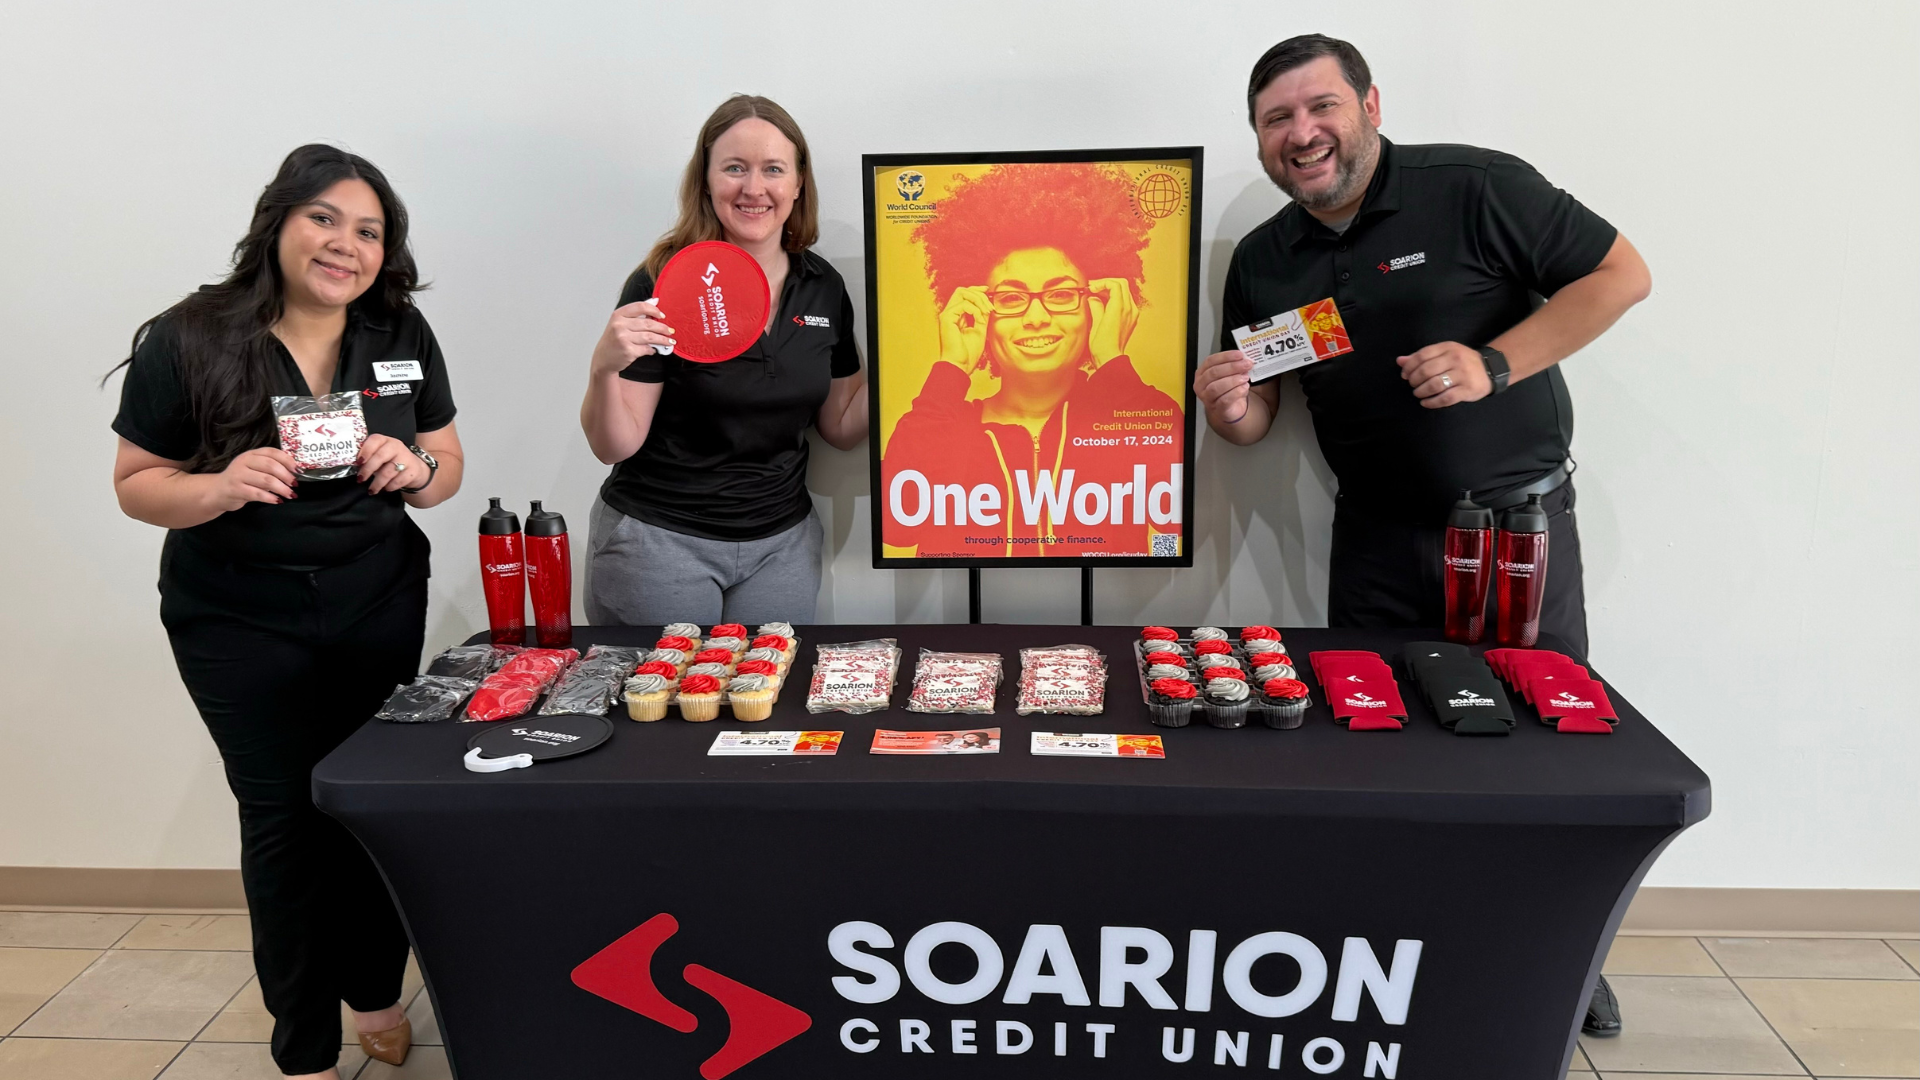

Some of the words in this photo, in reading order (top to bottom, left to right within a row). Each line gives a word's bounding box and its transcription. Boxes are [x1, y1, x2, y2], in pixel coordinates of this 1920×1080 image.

[1389, 251, 1425, 266] SOARION
[697, 295, 711, 335] soarion.org
[711, 286, 731, 337] SOARION
[376, 383, 411, 392] SOARION
[1113, 408, 1173, 418] International
[1092, 422, 1121, 431] Credit
[1124, 421, 1152, 430] Union
[1154, 421, 1173, 431] Day
[303, 440, 353, 453] SOARION
[1072, 436, 1121, 446] October
[1123, 436, 1139, 447] 17,
[1141, 435, 1173, 445] 2024
[888, 468, 1002, 527] One
[1013, 462, 1183, 526] World
[964, 535, 1004, 546] through
[1006, 535, 1064, 547] cooperative
[1066, 534, 1107, 544] finance.
[826, 682, 873, 690] SOARION
[928, 686, 977, 695] SOARION
[1344, 698, 1387, 706] SOARION
[1549, 699, 1594, 707] SOARION
[531, 730, 582, 741] SOARION
[827, 920, 1424, 1026] SOARION
[839, 1017, 1116, 1058] CREDIT
[1161, 1026, 1402, 1080] UNION
